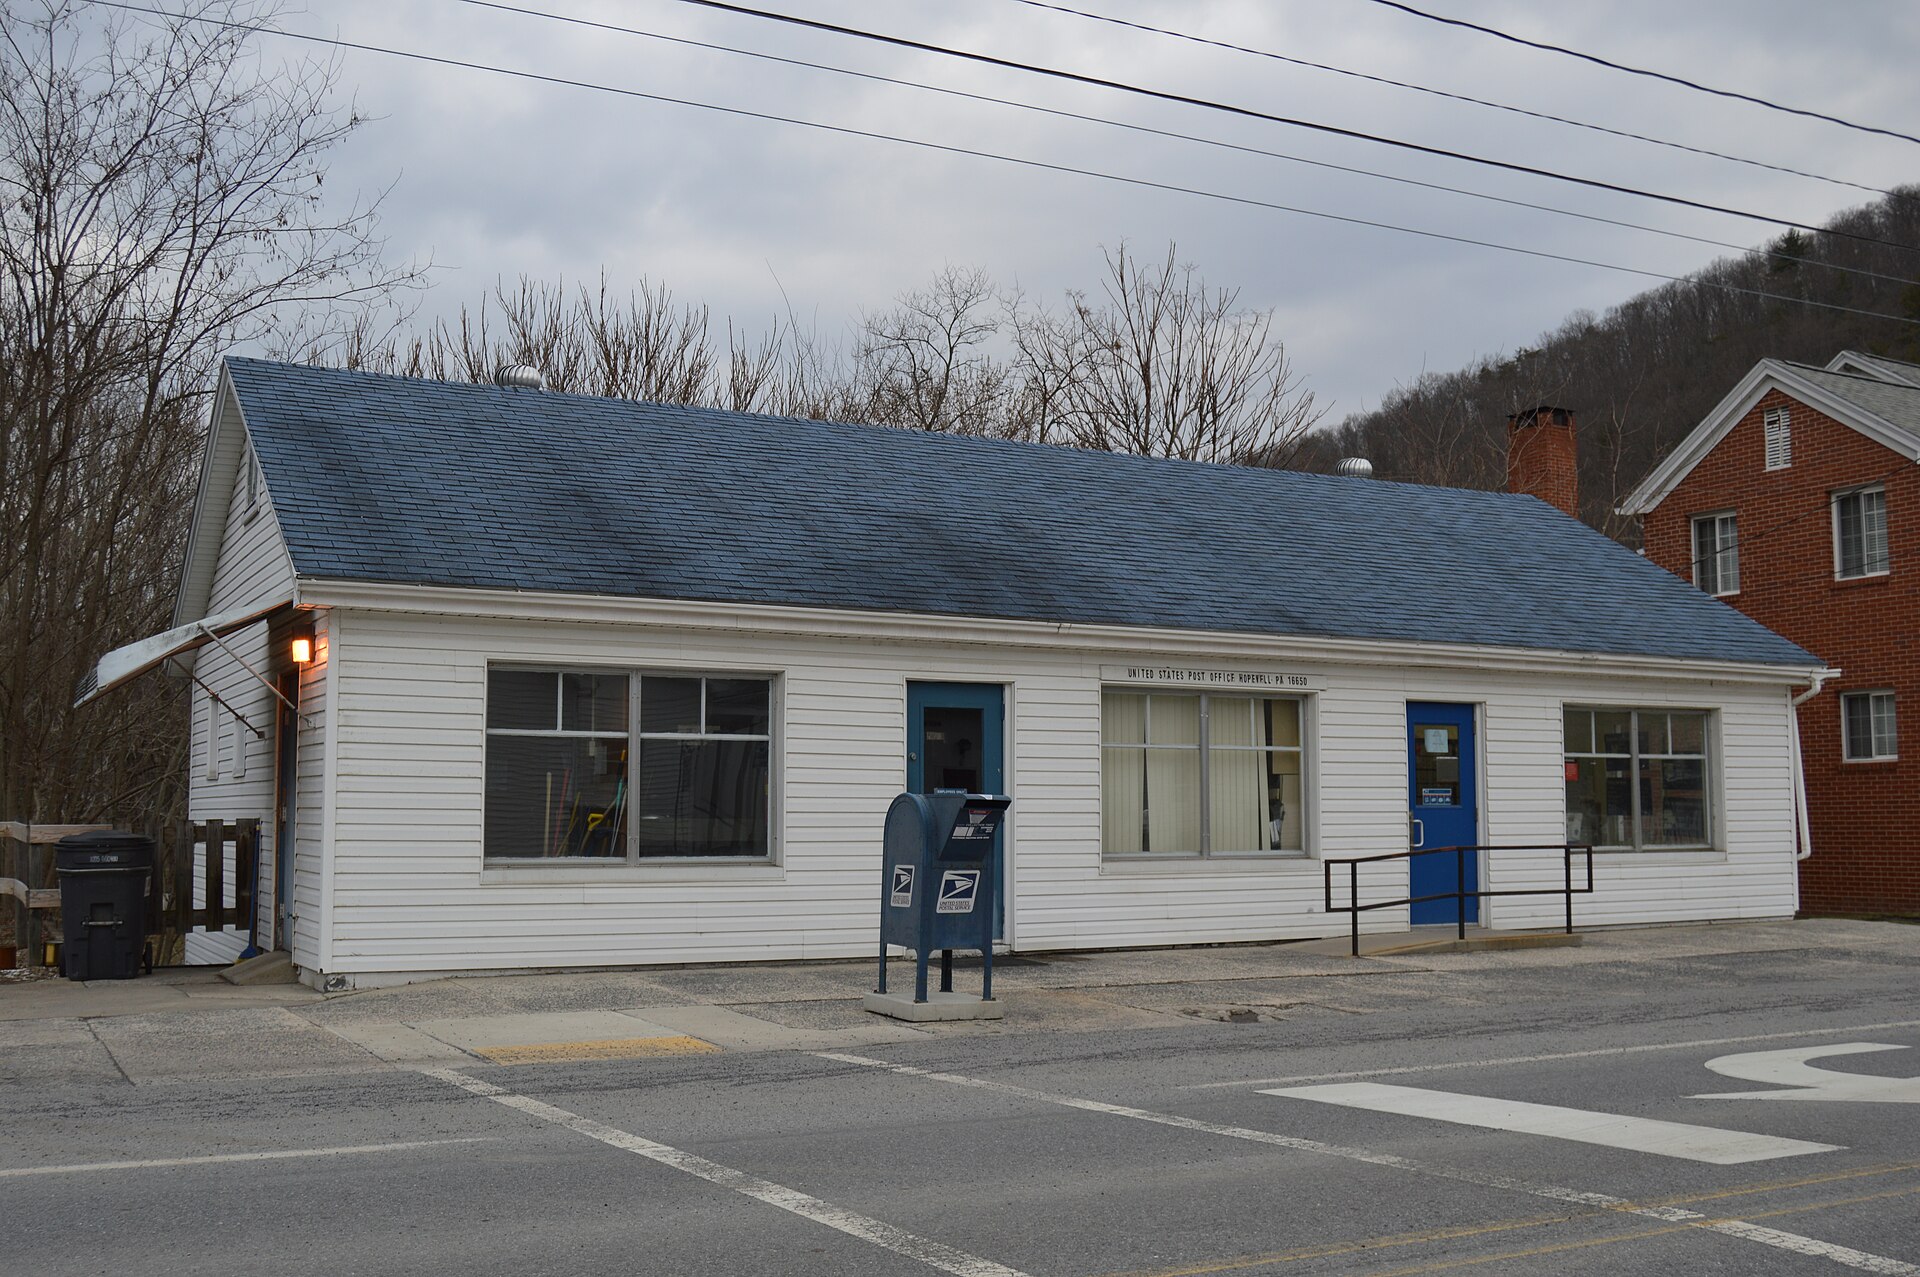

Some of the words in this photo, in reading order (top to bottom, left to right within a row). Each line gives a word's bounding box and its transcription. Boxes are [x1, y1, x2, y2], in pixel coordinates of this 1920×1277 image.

[1128, 668, 1154, 679] UNITED
[1159, 670, 1184, 681] STATES
[1188, 671, 1206, 682] POST
[1210, 672, 1235, 683] OFFICE
[1276, 676, 1285, 685] PA
[1287, 676, 1309, 688] 16650
